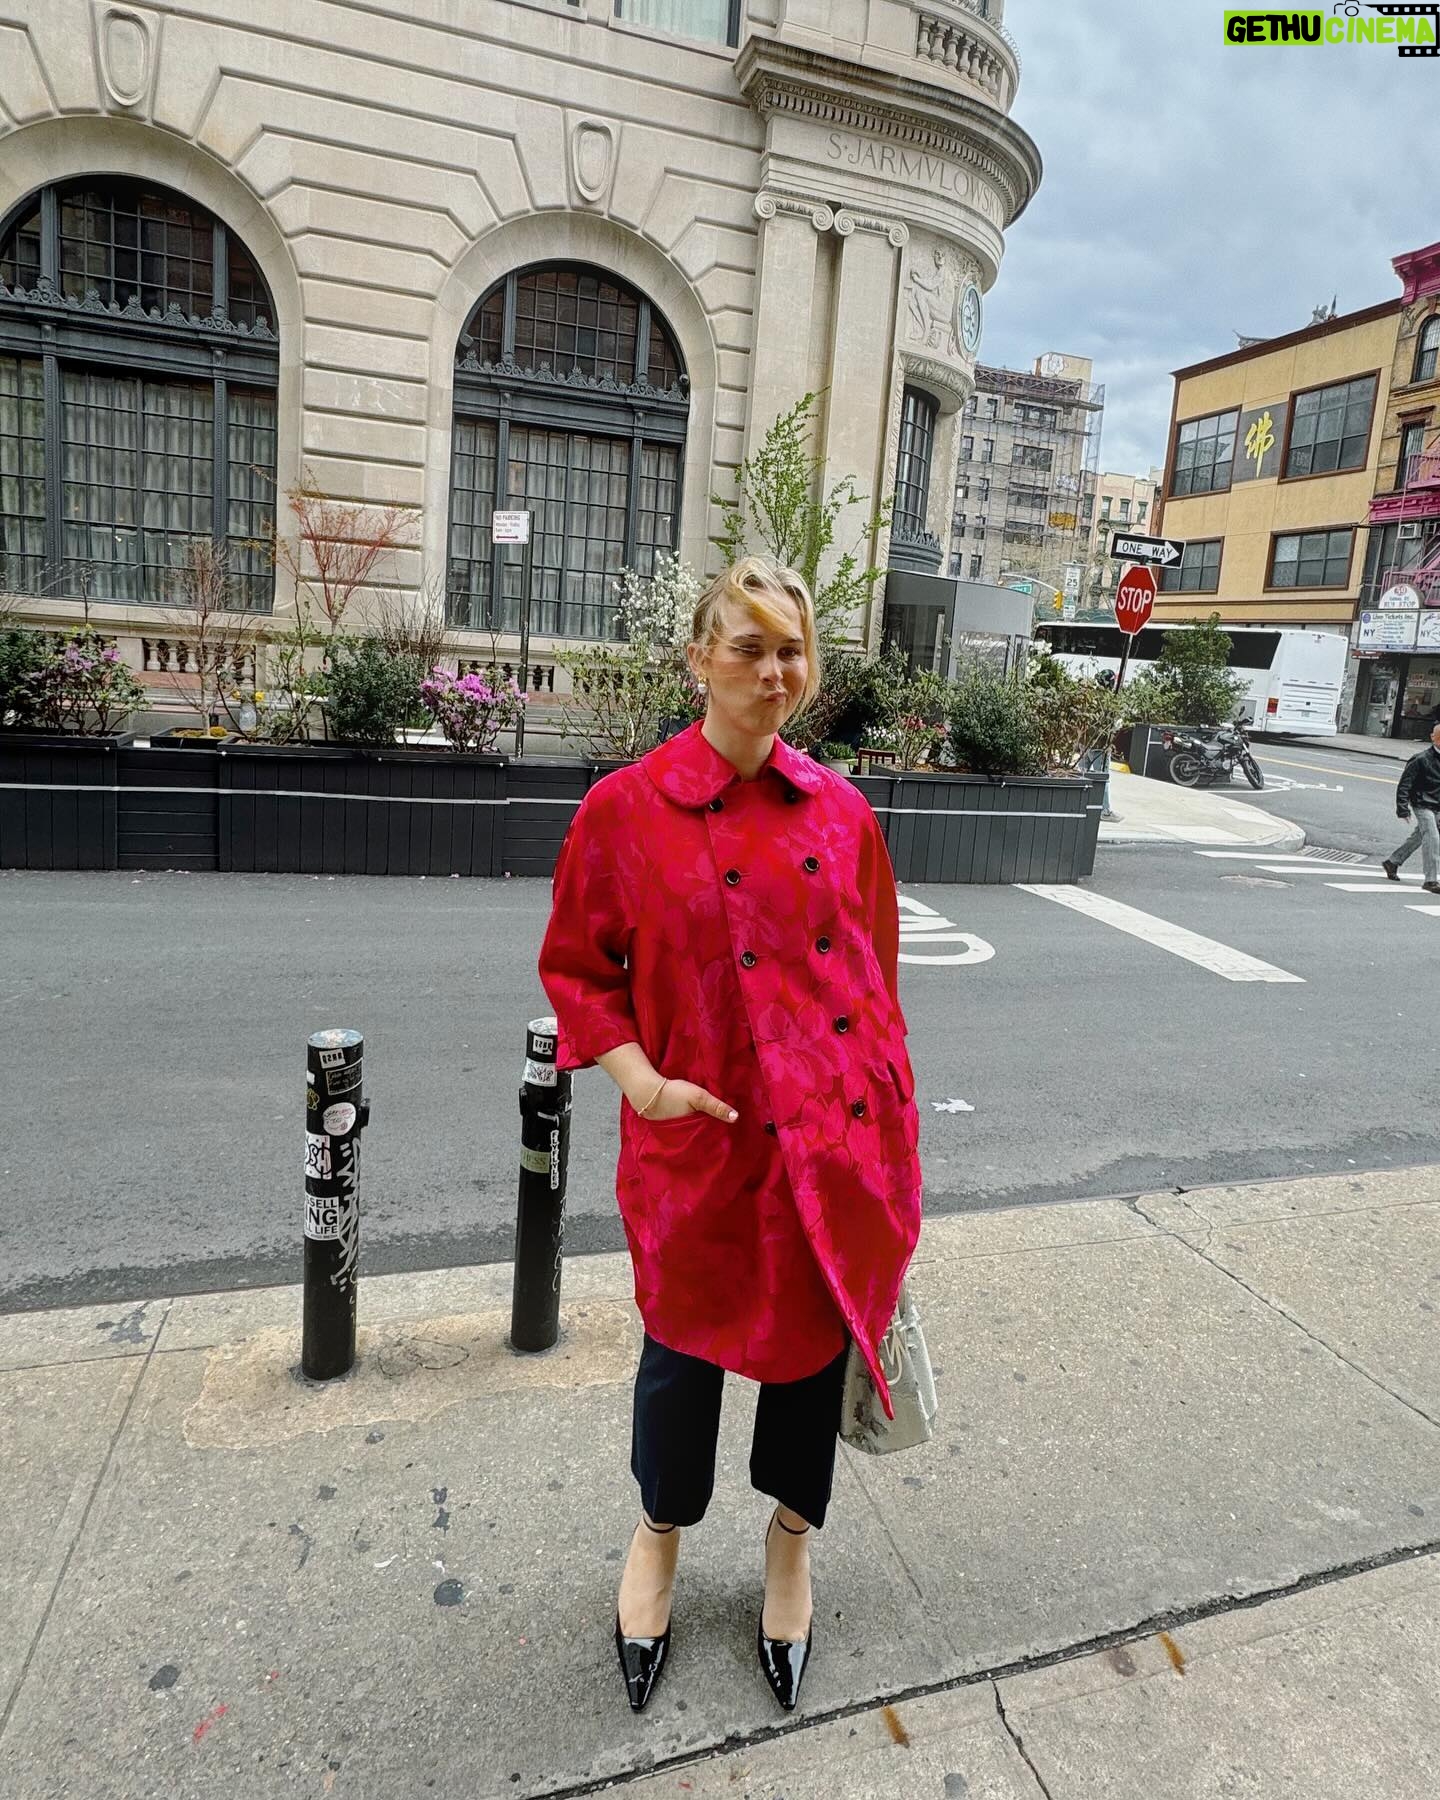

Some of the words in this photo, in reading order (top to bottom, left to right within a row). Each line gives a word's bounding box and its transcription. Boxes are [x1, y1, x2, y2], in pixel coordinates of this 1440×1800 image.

[1122, 542, 1143, 555] ONE
[1152, 546, 1173, 558] WAY
[1066, 578, 1078, 587] 25
[1117, 586, 1152, 614] STOP
[1363, 629, 1376, 637] NY
[315, 1226, 338, 1235] LIFE
